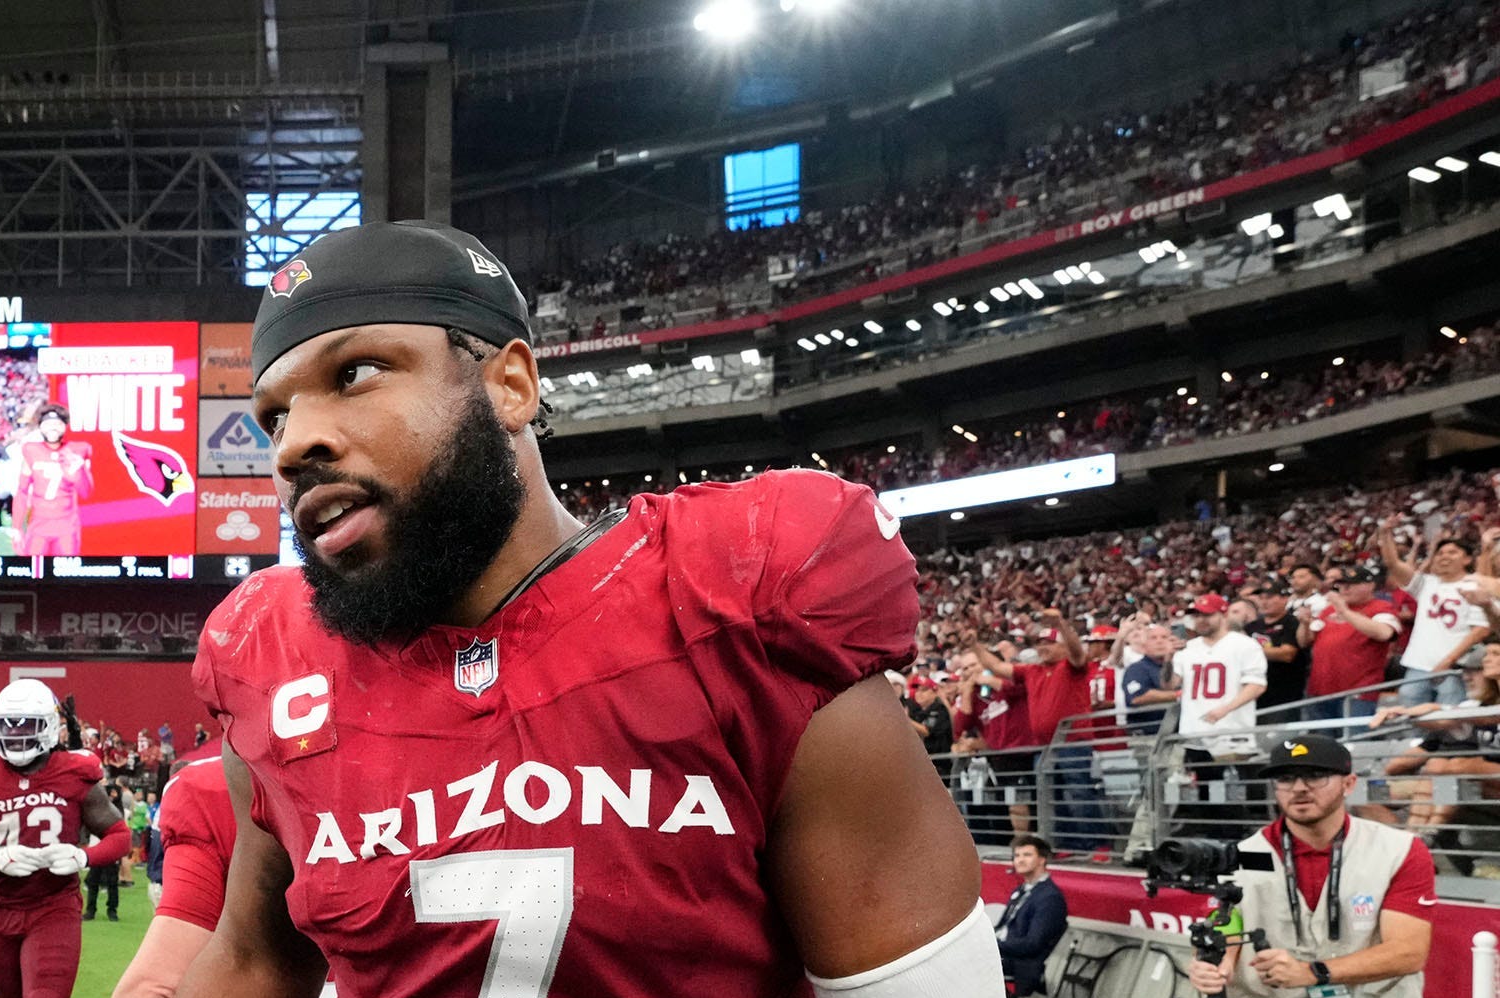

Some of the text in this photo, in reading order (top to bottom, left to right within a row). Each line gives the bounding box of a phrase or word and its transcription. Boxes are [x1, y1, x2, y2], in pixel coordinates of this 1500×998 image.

[1081, 211, 1124, 235] ROY
[1129, 187, 1205, 220] GREEN
[570, 334, 641, 354] DRISCOLL
[67, 374, 185, 431] WHITE
[206, 451, 271, 462] Albertsons
[32, 461, 63, 500] 7
[461, 661, 494, 685] NFL
[1191, 662, 1226, 700] 10
[272, 673, 329, 740] C
[306, 760, 736, 865] ARIZONA
